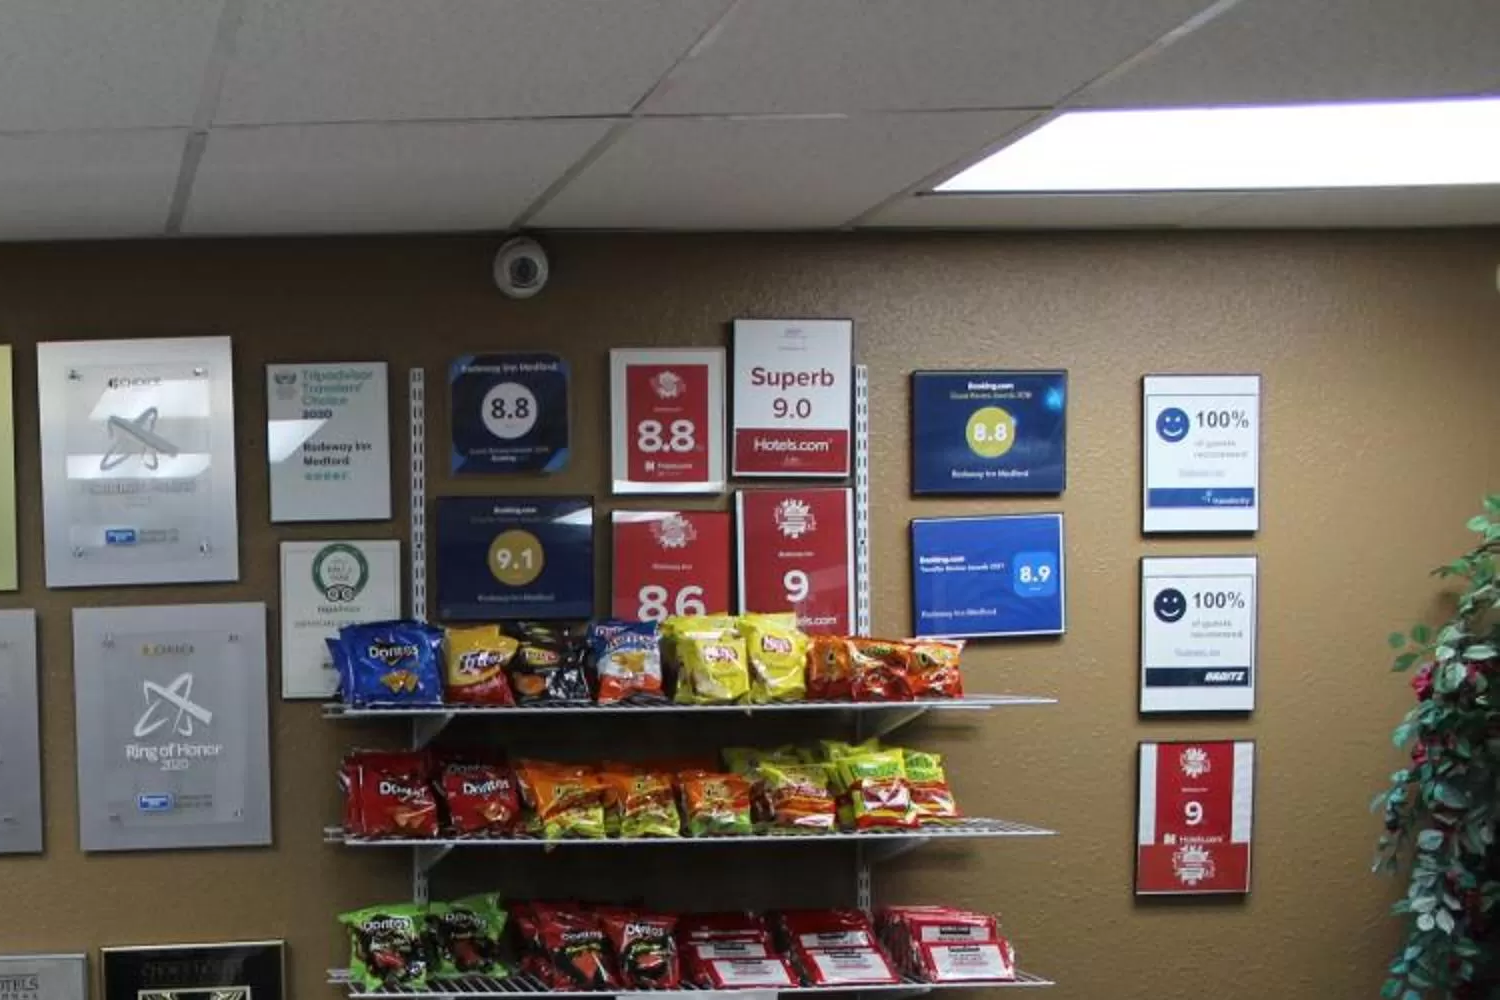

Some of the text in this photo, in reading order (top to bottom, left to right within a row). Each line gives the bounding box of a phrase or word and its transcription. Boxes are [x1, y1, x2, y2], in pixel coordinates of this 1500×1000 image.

[751, 366, 834, 391] Superb
[491, 398, 529, 419] 8.8
[772, 398, 812, 419] 9.0
[1196, 411, 1249, 429] 100%
[637, 419, 696, 453] 8.8
[973, 423, 1008, 442] 8.8
[754, 438, 830, 453] Hotels.com
[303, 455, 350, 466] Medford
[497, 549, 536, 570] 9.1
[1020, 566, 1051, 583] 8.9
[783, 570, 809, 602] 9
[1192, 591, 1245, 610] 100%
[368, 645, 419, 661] Doritos
[124, 743, 223, 762] Ring of Honor
[379, 781, 428, 798] Doritos
[463, 778, 510, 795] Doritos
[1183, 801, 1204, 824] 9
[362, 915, 411, 931] Doritos
[625, 922, 664, 938] Doritos
